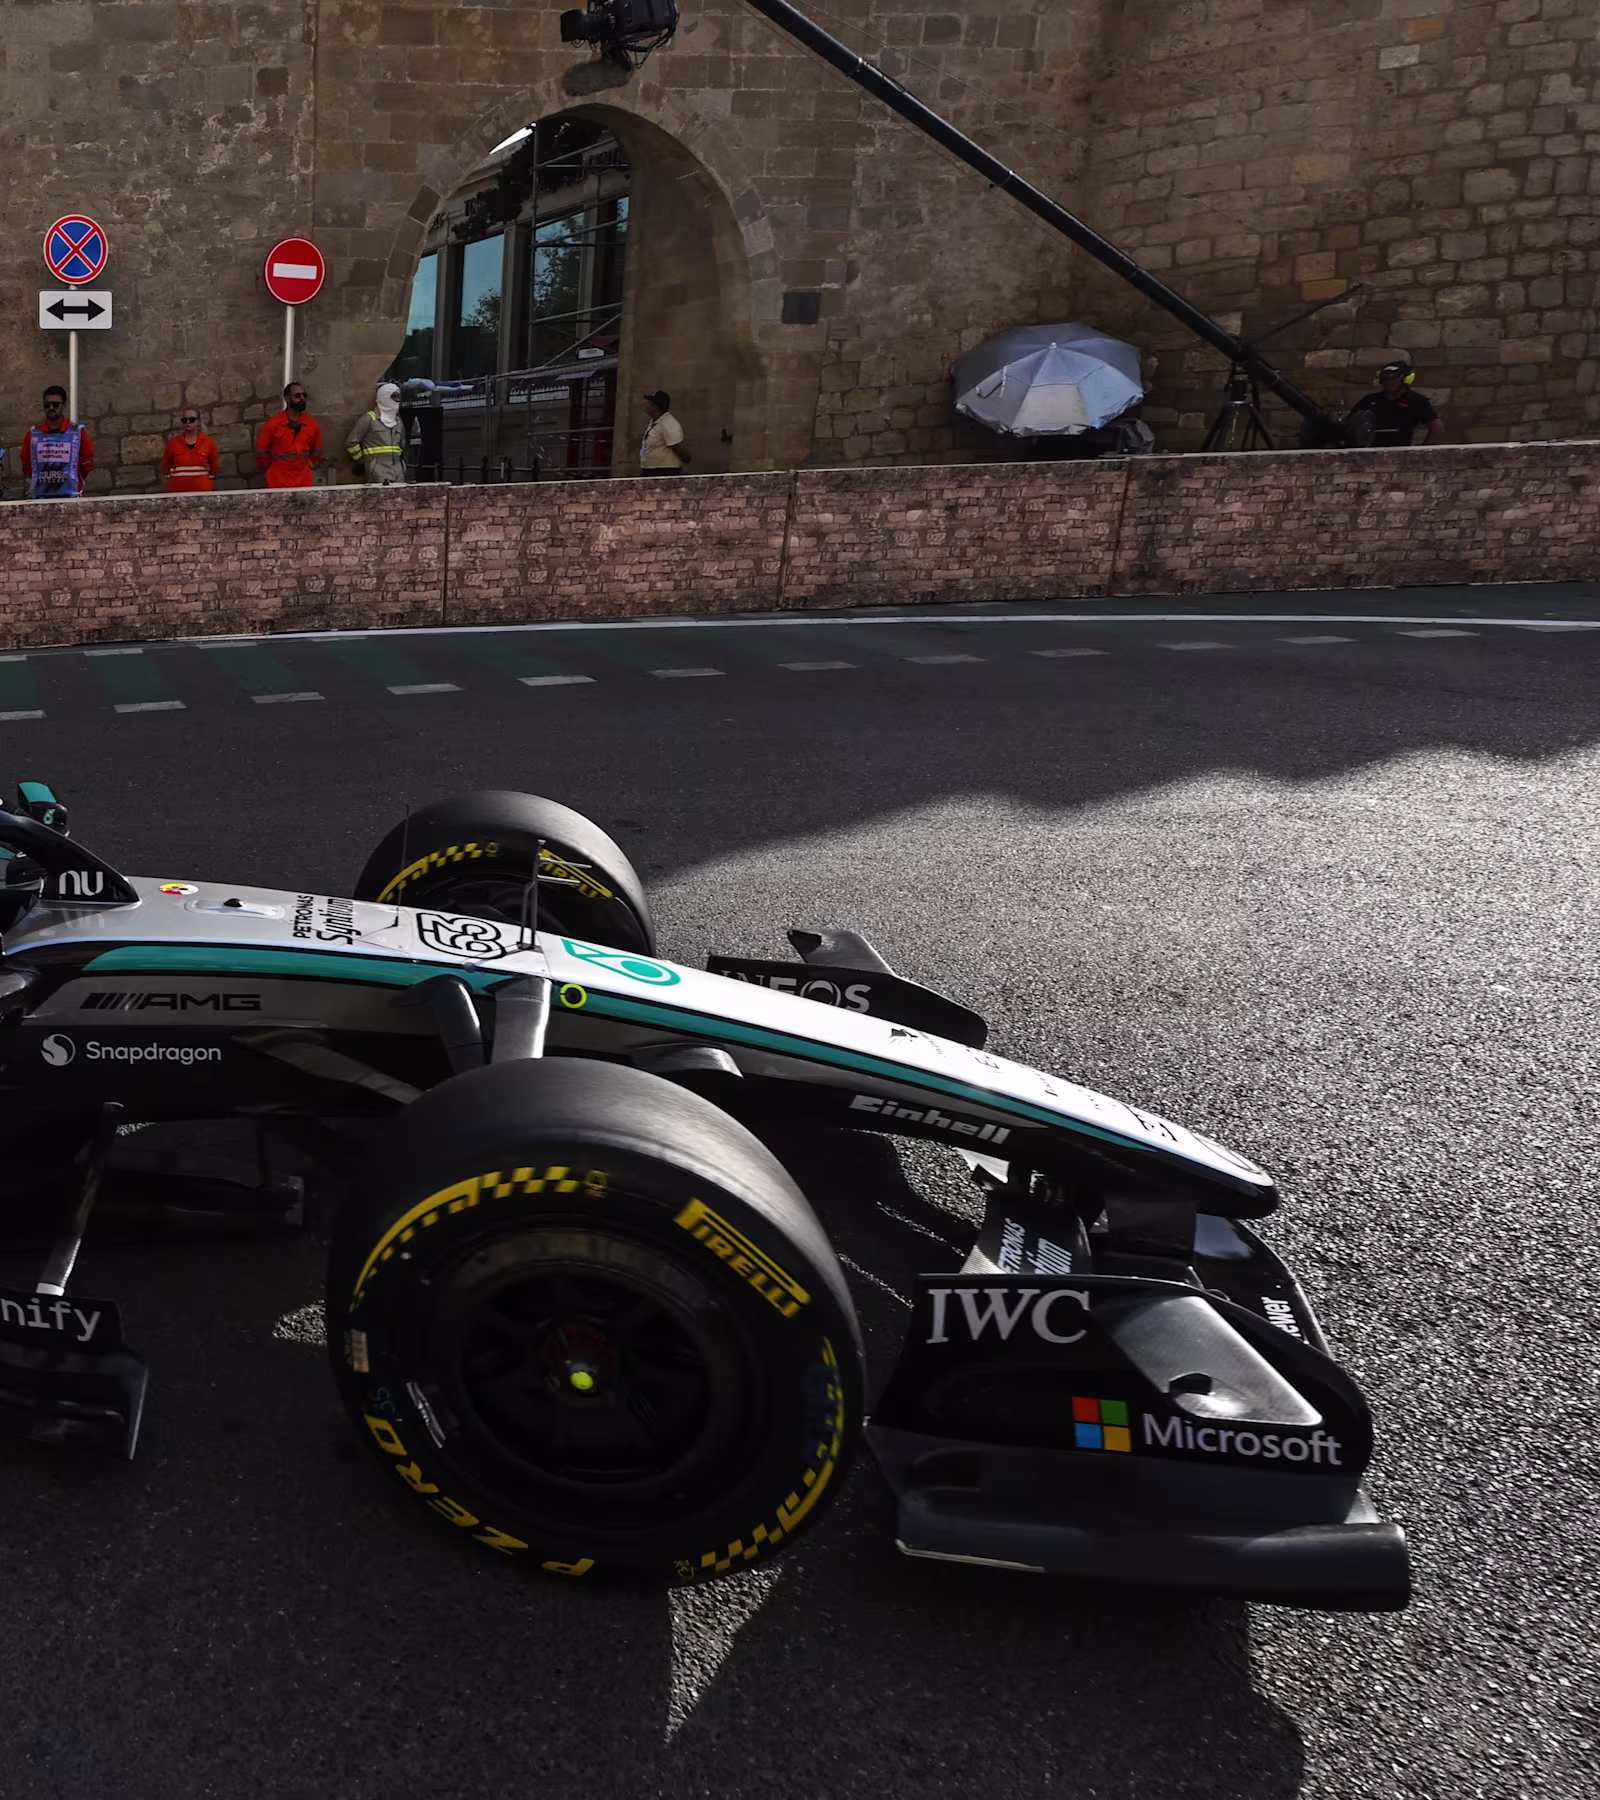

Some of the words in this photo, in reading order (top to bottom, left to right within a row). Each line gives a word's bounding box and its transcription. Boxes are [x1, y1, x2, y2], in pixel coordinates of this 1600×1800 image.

[293, 895, 314, 940] PETRONAS
[316, 898, 362, 946] Syntium
[416, 912, 507, 960] 63
[138, 993, 261, 1011] AMG
[720, 968, 873, 1015] EOS
[85, 1041, 223, 1066] Snapdragon
[848, 1094, 1012, 1145] Einhell
[672, 1197, 813, 1319] PIRELLI
[997, 1217, 1026, 1275] ETRONAS
[925, 1288, 1091, 1345] IWC
[1142, 1411, 1343, 1467] Microsoft
[363, 1412, 530, 1556] ZERO
[540, 1557, 596, 1577] P
